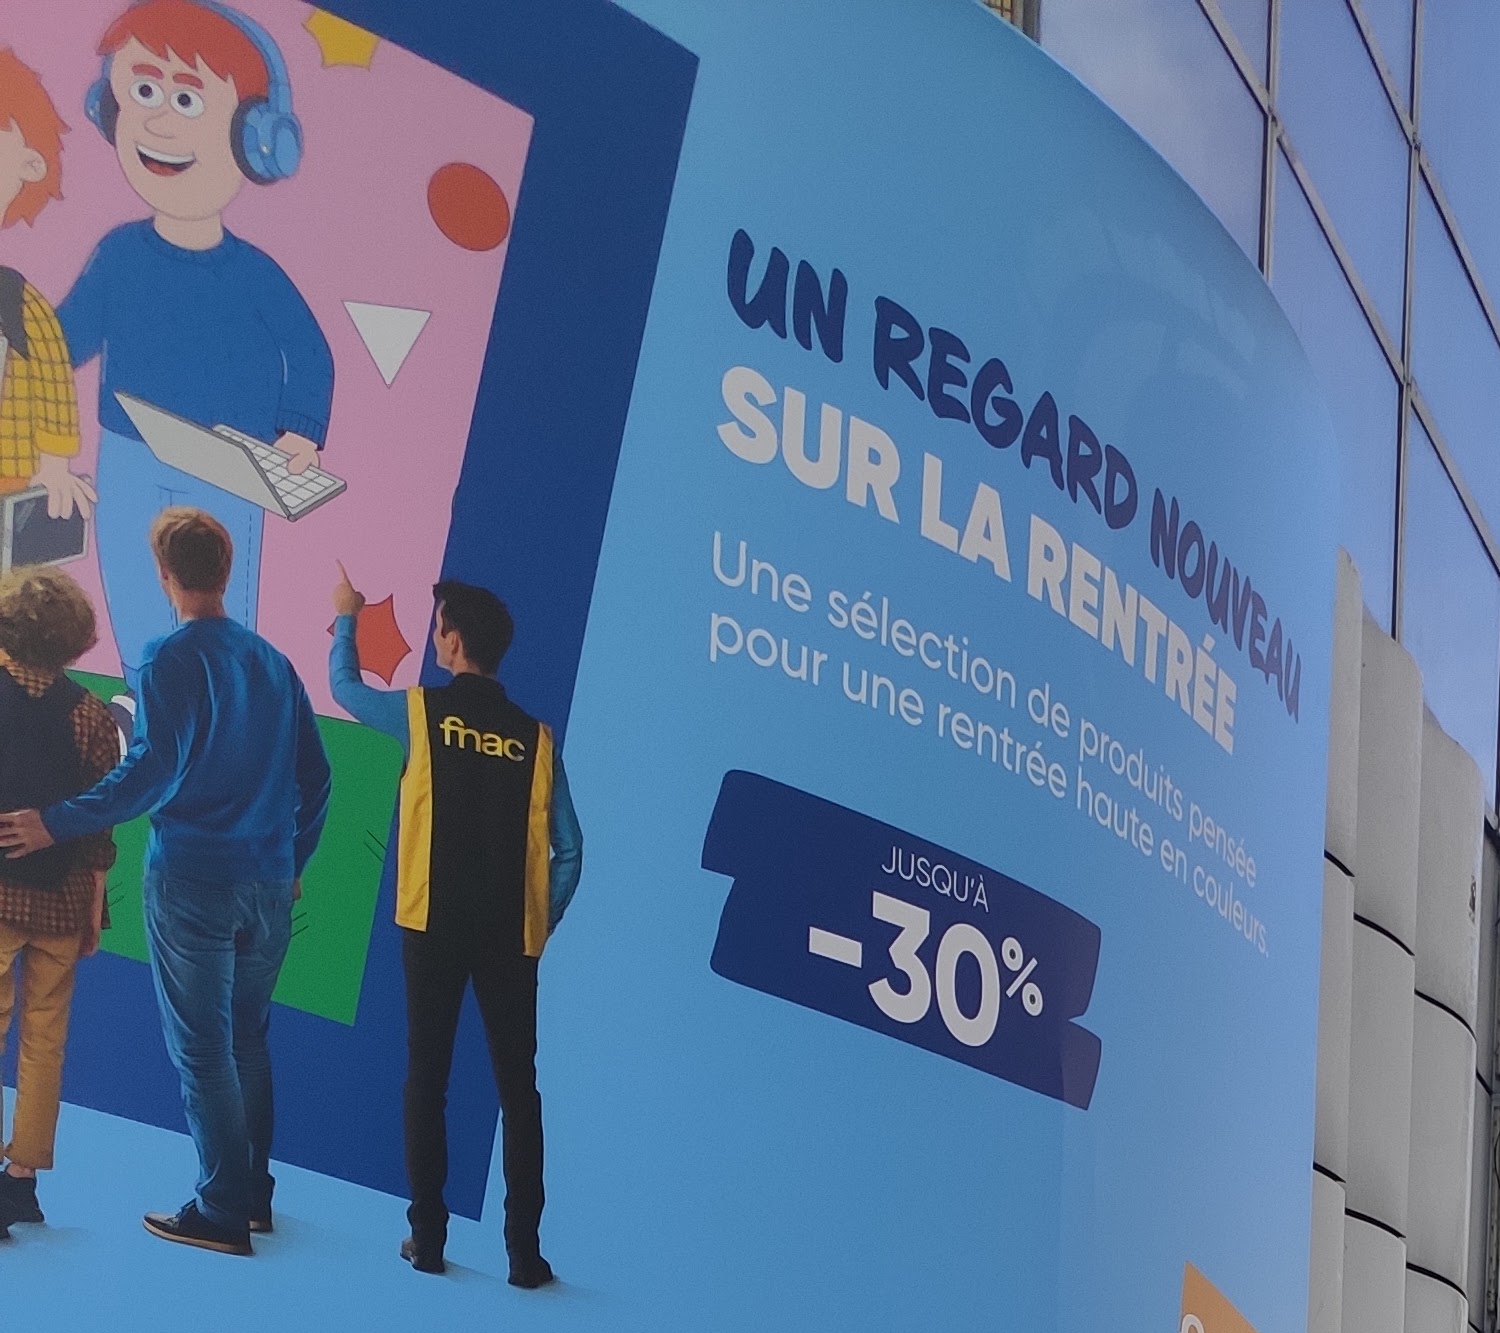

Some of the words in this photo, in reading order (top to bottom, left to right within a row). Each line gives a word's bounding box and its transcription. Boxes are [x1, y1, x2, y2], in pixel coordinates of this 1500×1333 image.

[716, 366, 900, 525] SUR
[921, 451, 1011, 582] LA
[1026, 514, 1238, 755] RENTRÉE
[727, 228, 847, 363] UN
[873, 296, 1138, 530] REGARD
[1150, 487, 1302, 723] NOUVEAU
[439, 716, 525, 762] fnac
[709, 612, 828, 685] pour
[842, 662, 924, 726] une
[938, 701, 1067, 799] rentrée
[1077, 767, 1154, 858] haute
[1160, 837, 1187, 885] en
[1193, 865, 1269, 958] couleurs.
[713, 531, 811, 612] Une
[828, 592, 1016, 709] sélection
[1028, 683, 1069, 738] de
[1079, 716, 1183, 821] produits
[1189, 802, 1256, 888] pensée
[882, 846, 990, 913] JUSQU'À
[808, 891, 1043, 1046] -30%
